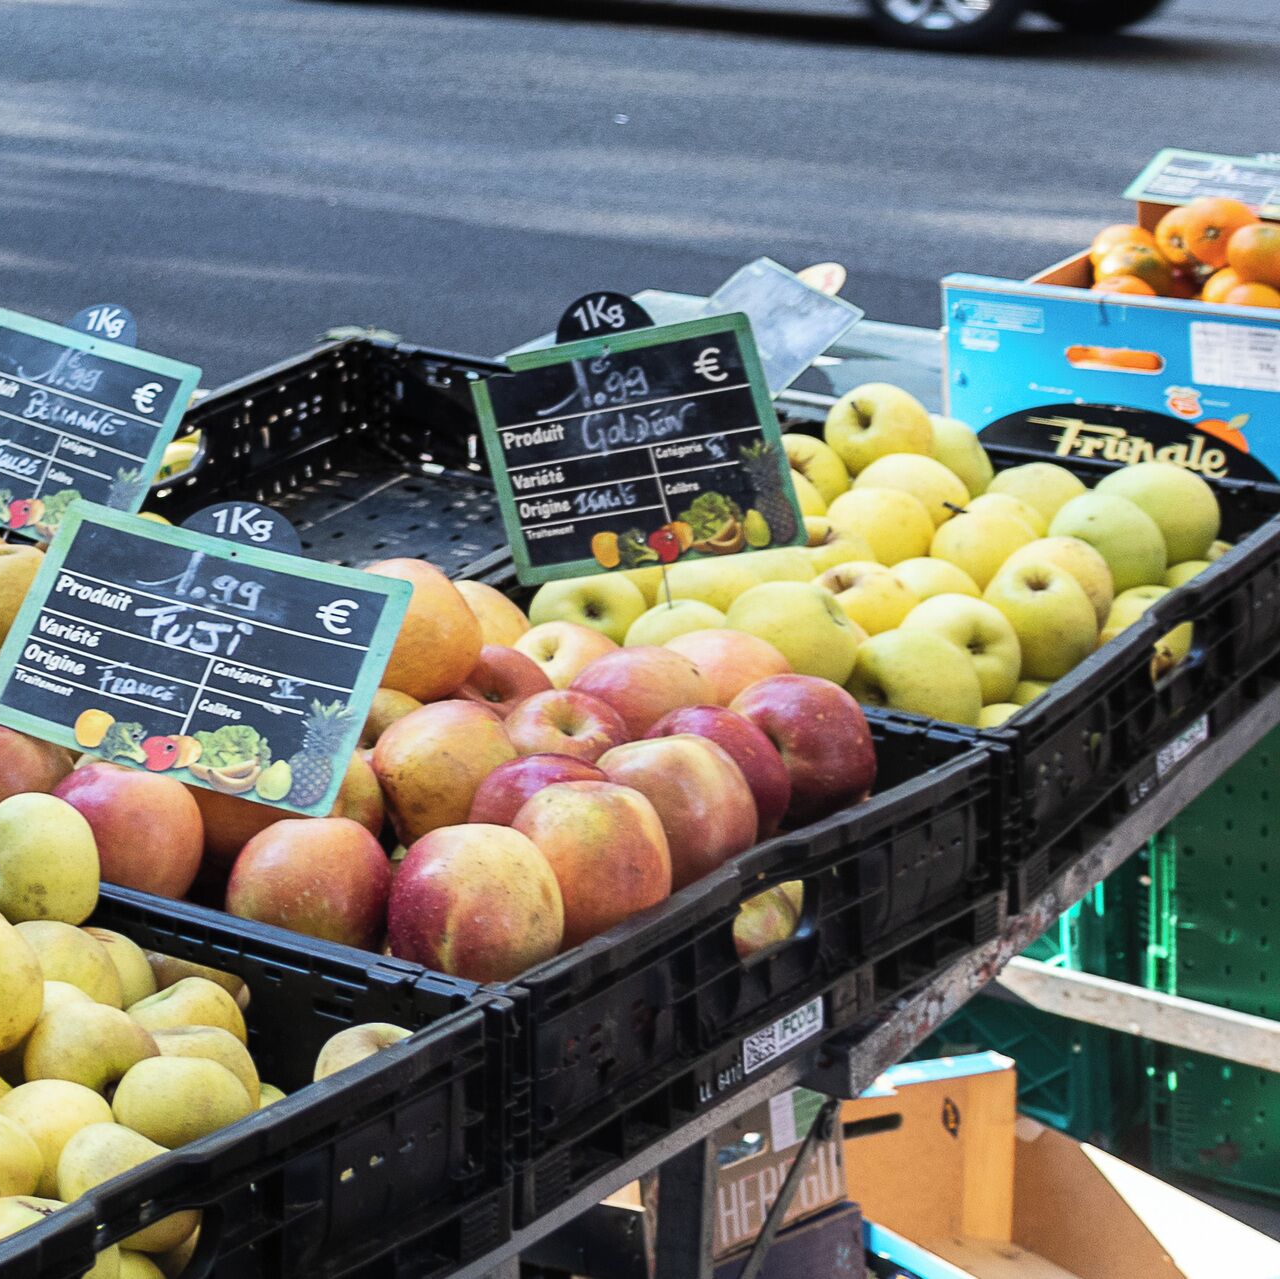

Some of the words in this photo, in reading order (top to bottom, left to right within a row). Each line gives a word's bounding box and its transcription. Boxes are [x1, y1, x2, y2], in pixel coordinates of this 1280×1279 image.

[87, 307, 126, 339] 1Kg
[573, 296, 626, 332] 1Kg
[693, 346, 729, 383] €
[131, 382, 164, 414] €
[502, 423, 566, 451] Produit
[512, 467, 566, 491] Variété
[655, 440, 704, 461] Catégorie
[212, 506, 275, 542] 1Kg
[520, 498, 572, 521] Origine
[526, 524, 575, 541] Traitement
[55, 574, 133, 613] Produit
[315, 599, 360, 635] €
[39, 615, 103, 649] Variété
[213, 662, 274, 689] Catégorie
[15, 669, 75, 698] Traitement
[24, 644, 86, 678] Origine
[198, 698, 243, 721] Calibre
